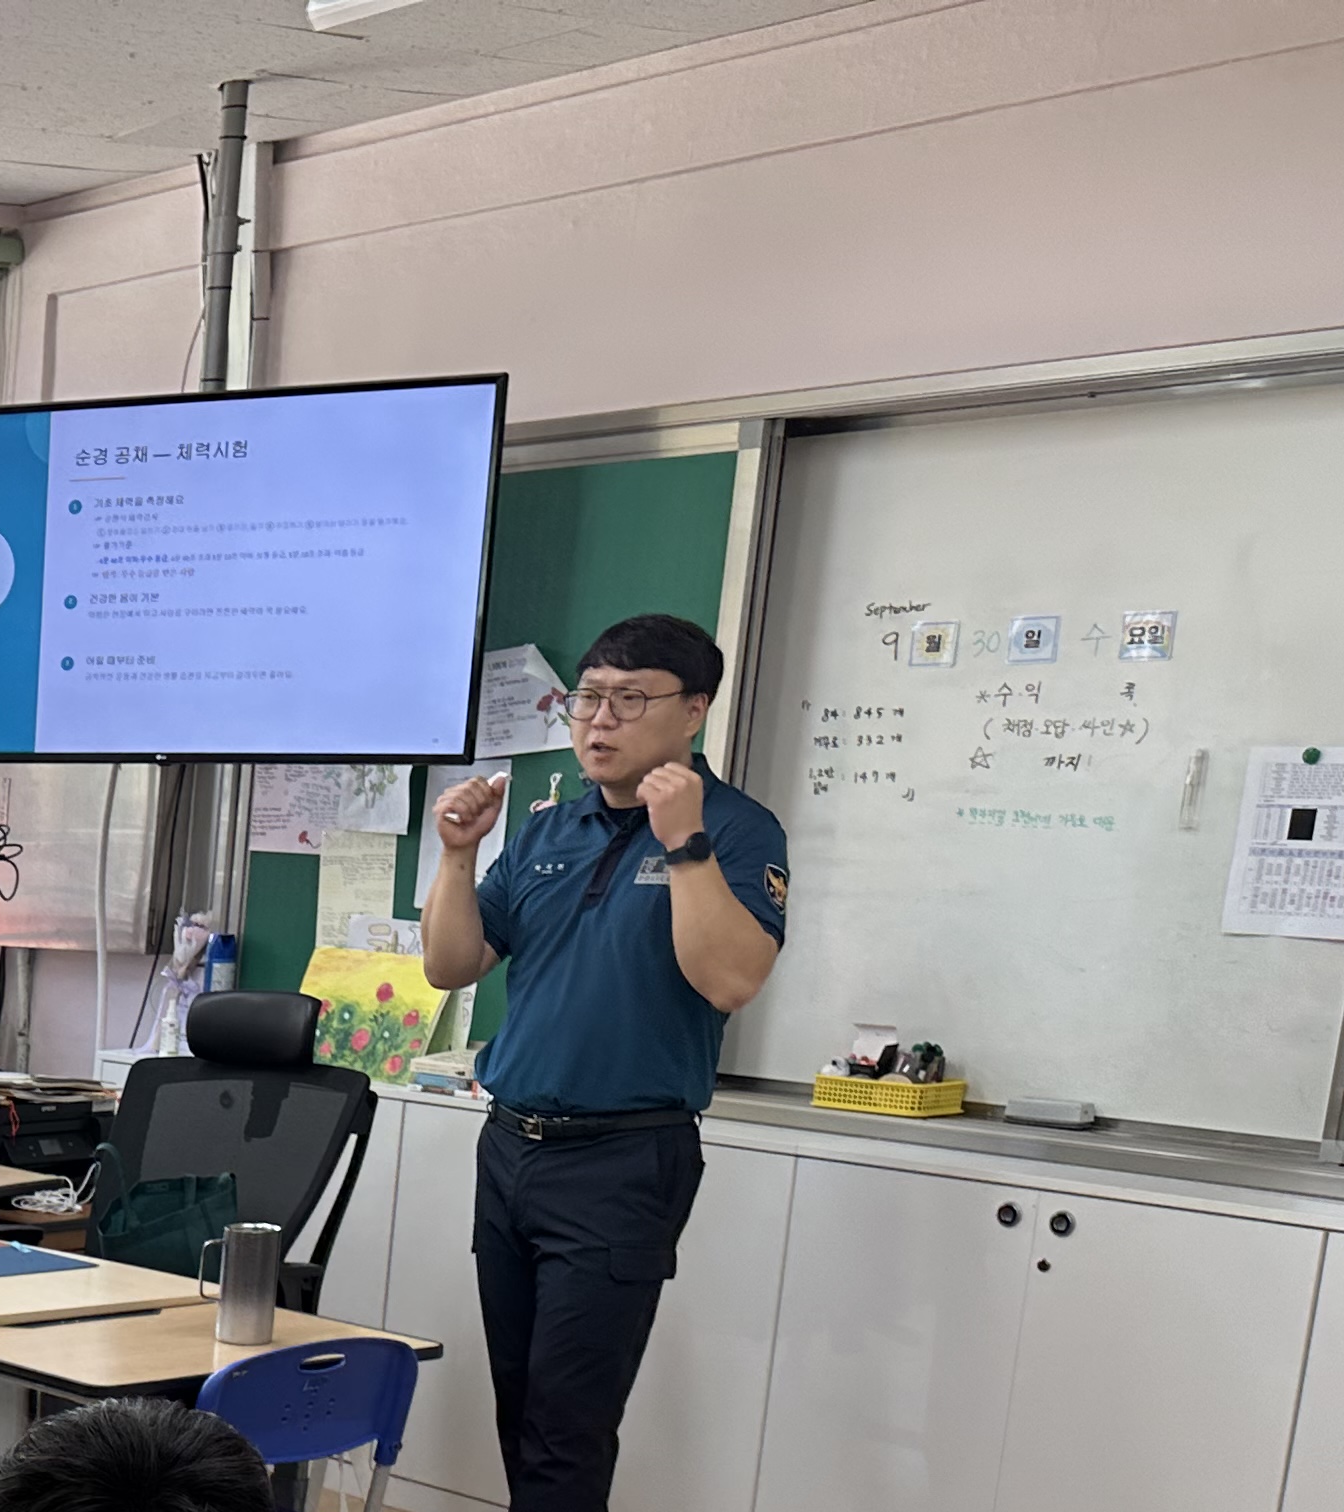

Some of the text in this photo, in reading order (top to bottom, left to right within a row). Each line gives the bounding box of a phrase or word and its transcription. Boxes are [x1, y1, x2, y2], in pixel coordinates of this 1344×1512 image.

[75, 447, 108, 467] 순경
[114, 445, 148, 464] 공채
[176, 440, 248, 461] 체력시험
[882, 623, 1165, 661] 9 월 30 일 수 요일
